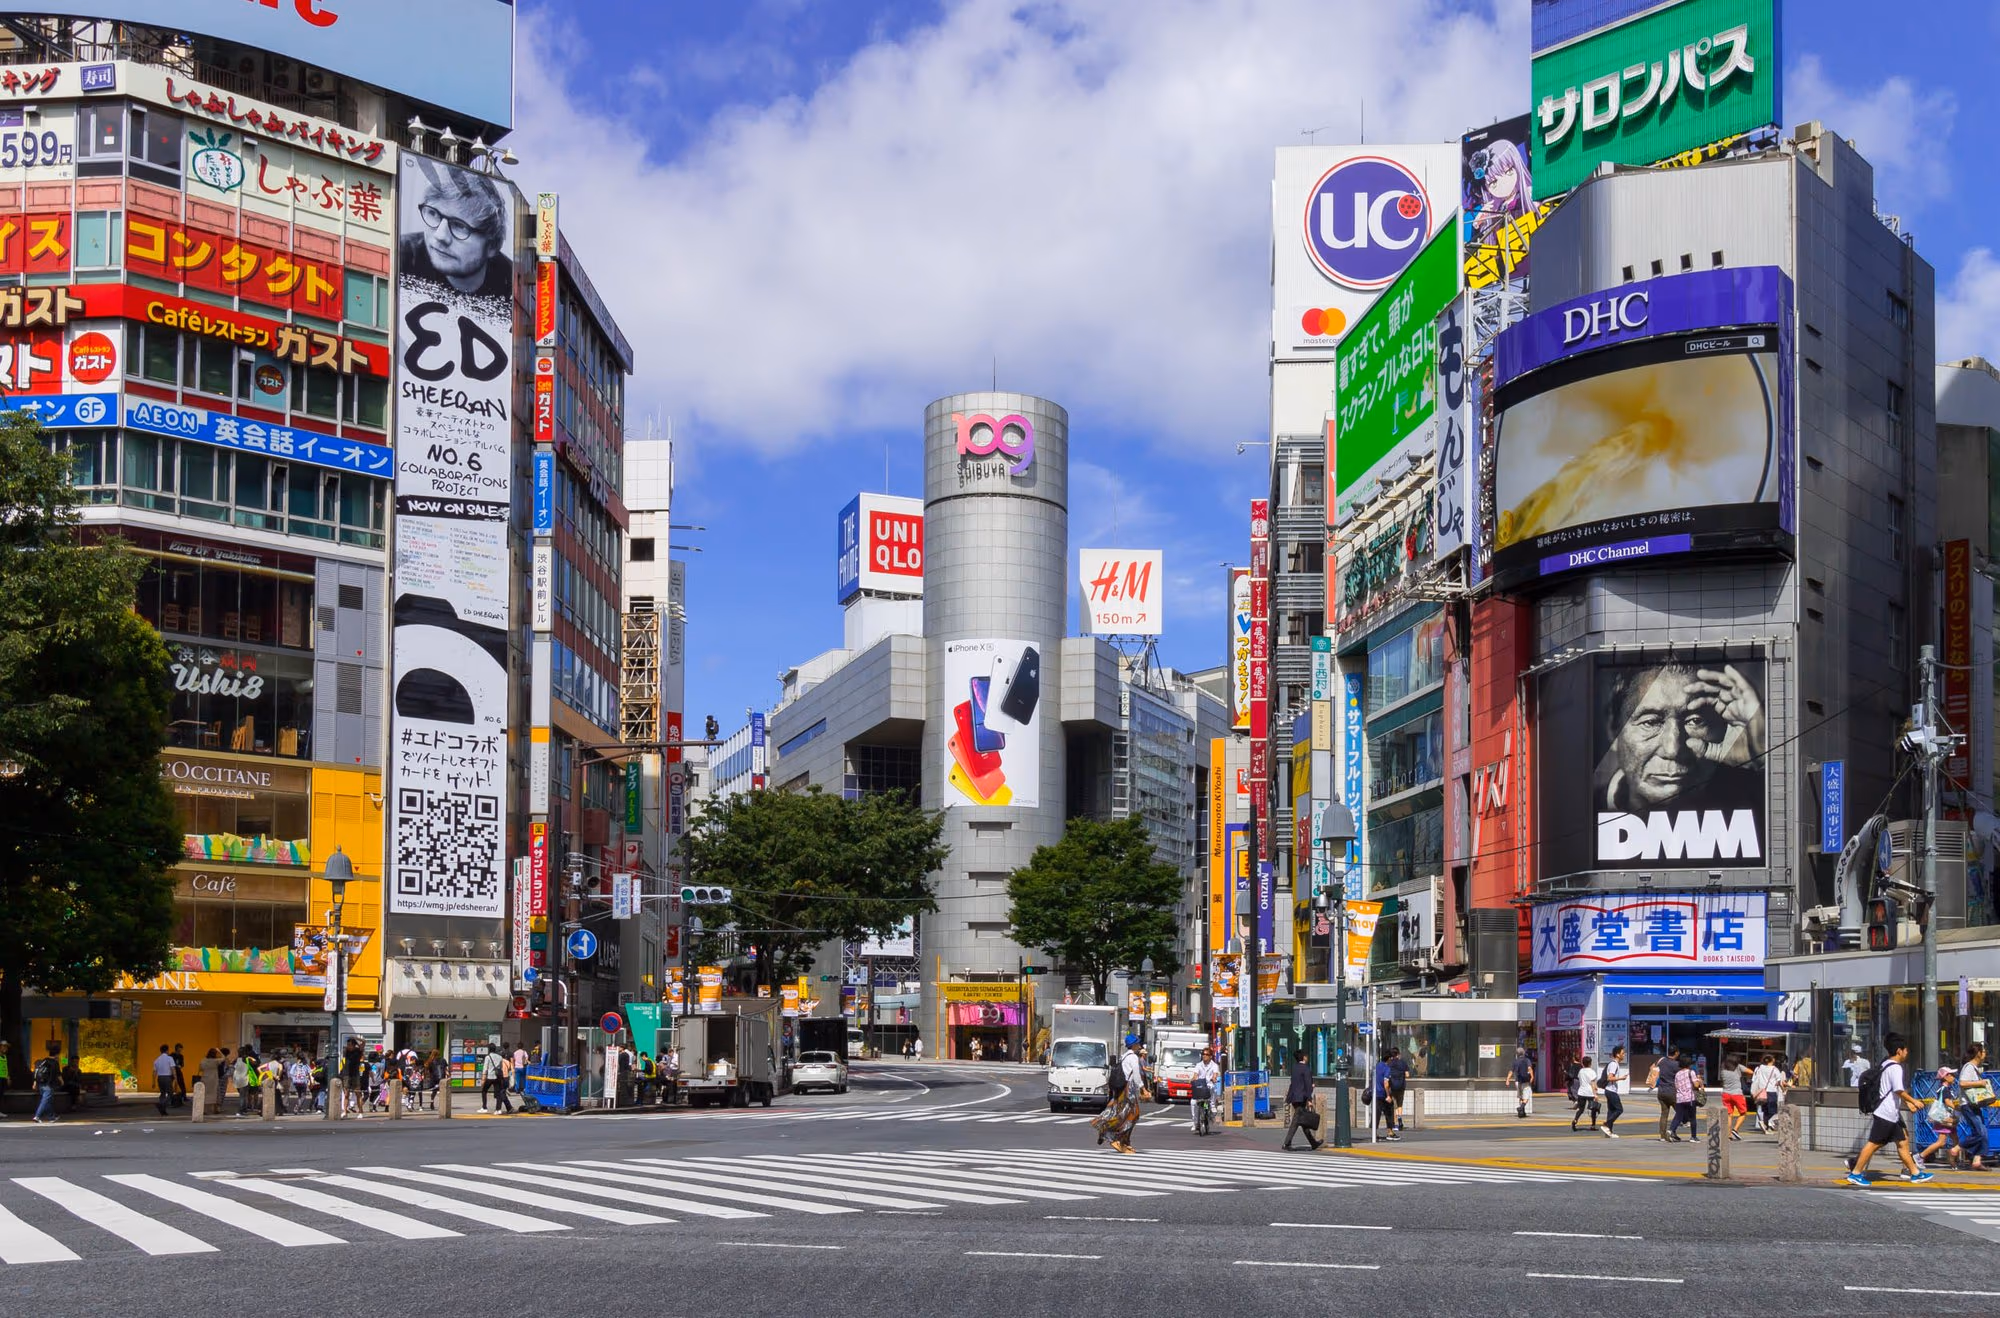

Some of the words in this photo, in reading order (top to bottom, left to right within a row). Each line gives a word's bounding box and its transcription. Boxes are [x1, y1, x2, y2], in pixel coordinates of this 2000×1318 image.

[84, 69, 112, 84] 寿司
[1538, 24, 1754, 145] サロンパス
[166, 78, 384, 160] しゃぶしゃぶバイキング
[259, 153, 382, 222] しゃぶ葉
[541, 211, 553, 252] しゃぶ葉
[128, 219, 335, 302] コンタクト
[0, 287, 82, 326] ガスト
[1563, 291, 1648, 344] DHC
[276, 326, 369, 374] ガスト
[403, 301, 508, 381] ED
[1690, 341, 1730, 351] DHCビール
[75, 355, 112, 371] ガスト
[79, 402, 102, 419] 6F
[402, 382, 508, 421] SHEERAN
[539, 393, 550, 432] ガスト
[137, 404, 198, 434] AEON
[215, 417, 389, 470] 英会話イーオン
[952, 412, 1034, 475] 109
[1438, 308, 1465, 544] もんじゃ
[400, 461, 508, 489] COLLABORATIONS
[432, 479, 479, 496] PROJECT
[538, 460, 549, 527] 英会話イーオン
[408, 501, 441, 512] NOW
[444, 504, 464, 514] ON
[467, 504, 497, 516] SALE
[876, 519, 917, 544] UNI
[876, 545, 921, 570] QLO
[1569, 549, 1596, 567] DHC
[1598, 541, 1649, 560] Channel
[537, 553, 547, 623] 渋谷駅前ビル
[1090, 561, 1152, 603] H&M
[1096, 613, 1119, 624] 150
[954, 643, 978, 652] iPhone
[401, 728, 499, 754] #エドコラボ
[1948, 695, 1968, 778] 三里
[401, 766, 441, 780] カードを
[628, 765, 637, 789] レイク
[1827, 767, 1840, 848] 大盛堂商事ビル
[1214, 799, 1223, 858] Matsumoto
[1598, 809, 1760, 860] DMM
[193, 874, 236, 895] Café
[533, 849, 544, 909] サンドラッグ
[1261, 873, 1269, 910] MIZUHO
[397, 900, 498, 912] https://wmg.jp/edsheeran/
[1540, 908, 1746, 957] 大盛堂書店
